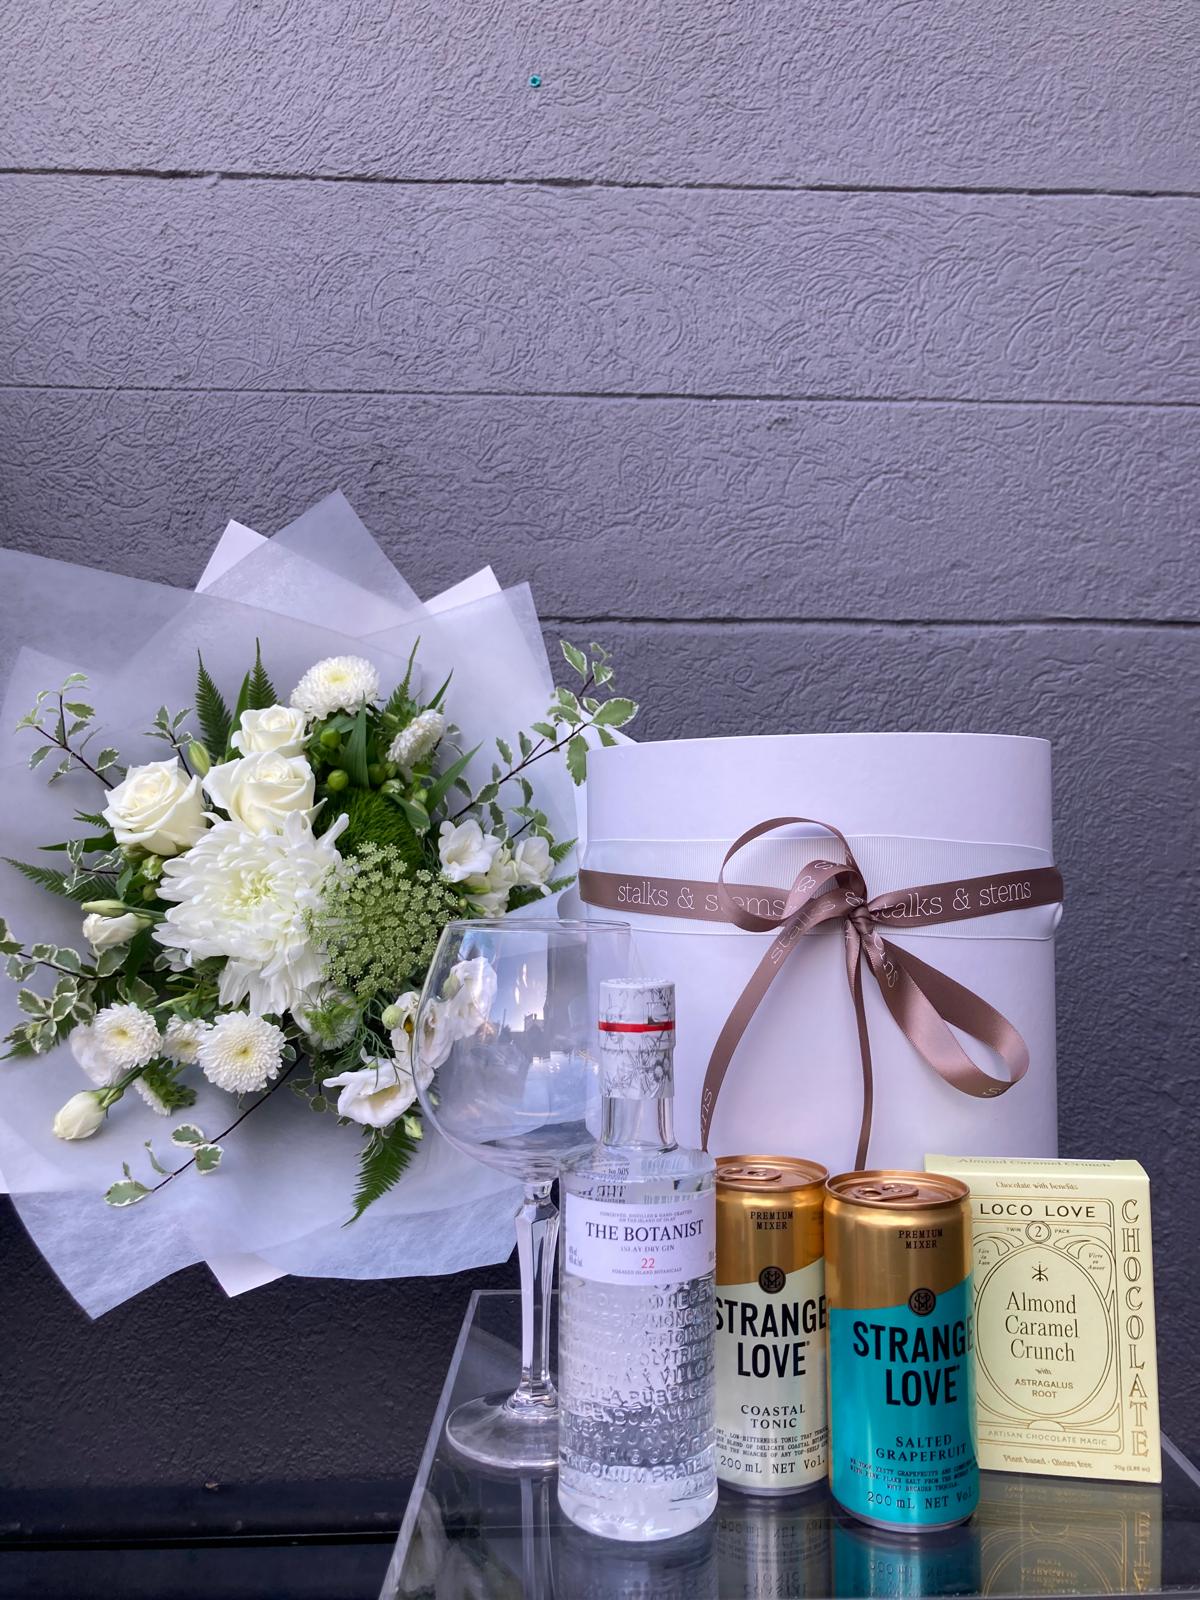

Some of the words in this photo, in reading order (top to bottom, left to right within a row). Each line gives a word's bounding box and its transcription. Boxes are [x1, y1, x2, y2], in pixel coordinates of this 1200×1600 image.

[617, 881, 669, 907] stalks
[676, 887, 695, 910] &
[704, 893, 786, 917] sems
[952, 888, 971, 911] &
[979, 881, 1032, 907] stems
[995, 1180, 1032, 1189] Chocolate
[750, 1211, 794, 1220] PREMIUM
[980, 1203, 1033, 1216] LOCO
[1045, 1205, 1096, 1218] LOVE
[585, 1221, 618, 1241] THE
[623, 1219, 704, 1242] BOTANIST
[756, 1221, 788, 1230] MIXER
[1034, 1225, 1042, 1238] 2
[898, 1228, 944, 1239] PREMIUM
[661, 1244, 675, 1252] GIN
[905, 1239, 938, 1249] MIXER
[641, 1257, 656, 1269] 22
[1006, 1291, 1077, 1314] Almond
[716, 1294, 826, 1338] STRANGE
[1005, 1315, 1079, 1338] Caramel
[1121, 1199, 1149, 1457] CHOCOLATE
[853, 1316, 974, 1363] STRANGE
[1010, 1338, 1075, 1362] Crunch
[737, 1341, 806, 1378] LOVE
[885, 1366, 958, 1407] LOVE
[1014, 1378, 1074, 1390] ASTRAGALUS
[1032, 1389, 1057, 1399] ROOT
[740, 1404, 806, 1417] COASTAL
[750, 1418, 797, 1429] TONIC
[781, 1435, 798, 1444] TONIC
[788, 1440, 810, 1450] COASTAL
[895, 1434, 952, 1449] SALTED
[988, 1430, 1023, 1439] ARTISAN
[1026, 1433, 1077, 1444] CHOCOLATE
[1080, 1438, 1108, 1446] MAGIC
[875, 1443, 967, 1462] GRAPEFRUIT
[1002, 1454, 1023, 1463] Plant
[720, 1455, 741, 1470] 200
[745, 1463, 762, 1474] mL
[772, 1462, 796, 1474] NET
[803, 1455, 825, 1470] Vol.
[867, 1491, 892, 1506] 200
[896, 1498, 915, 1509] mL
[925, 1495, 949, 1509] NET
